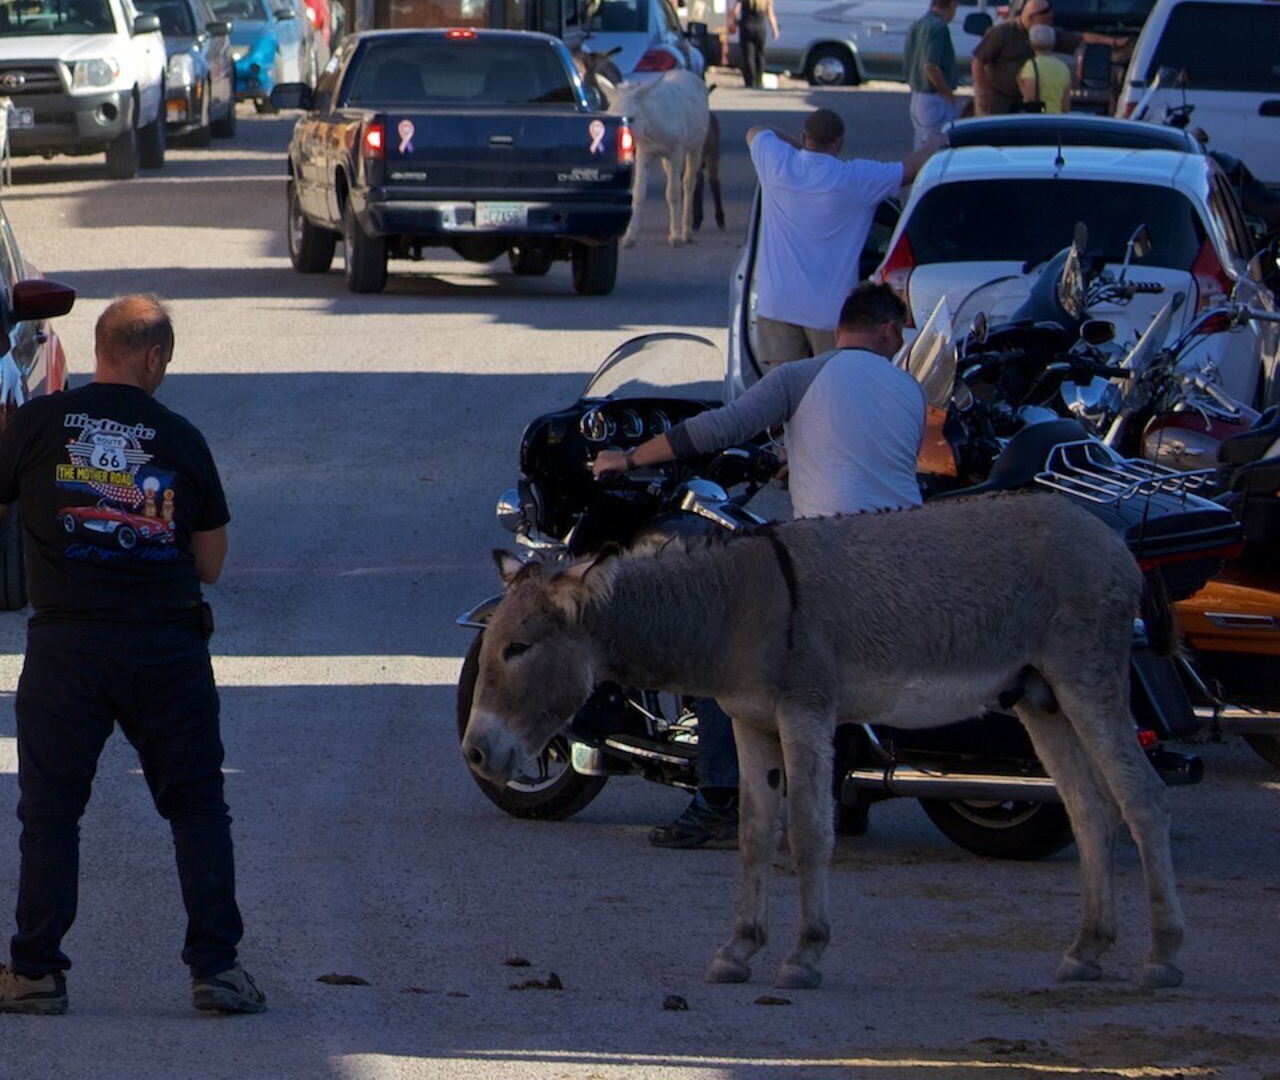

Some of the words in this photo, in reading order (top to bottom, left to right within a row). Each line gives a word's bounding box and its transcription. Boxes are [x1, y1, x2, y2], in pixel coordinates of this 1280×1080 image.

[64, 413, 156, 441] Historic
[96, 436, 123, 447] ROUTE
[99, 454, 120, 469] 66
[59, 467, 75, 479] THE
[76, 469, 109, 483] MOTHER
[109, 471, 134, 486] ROAD
